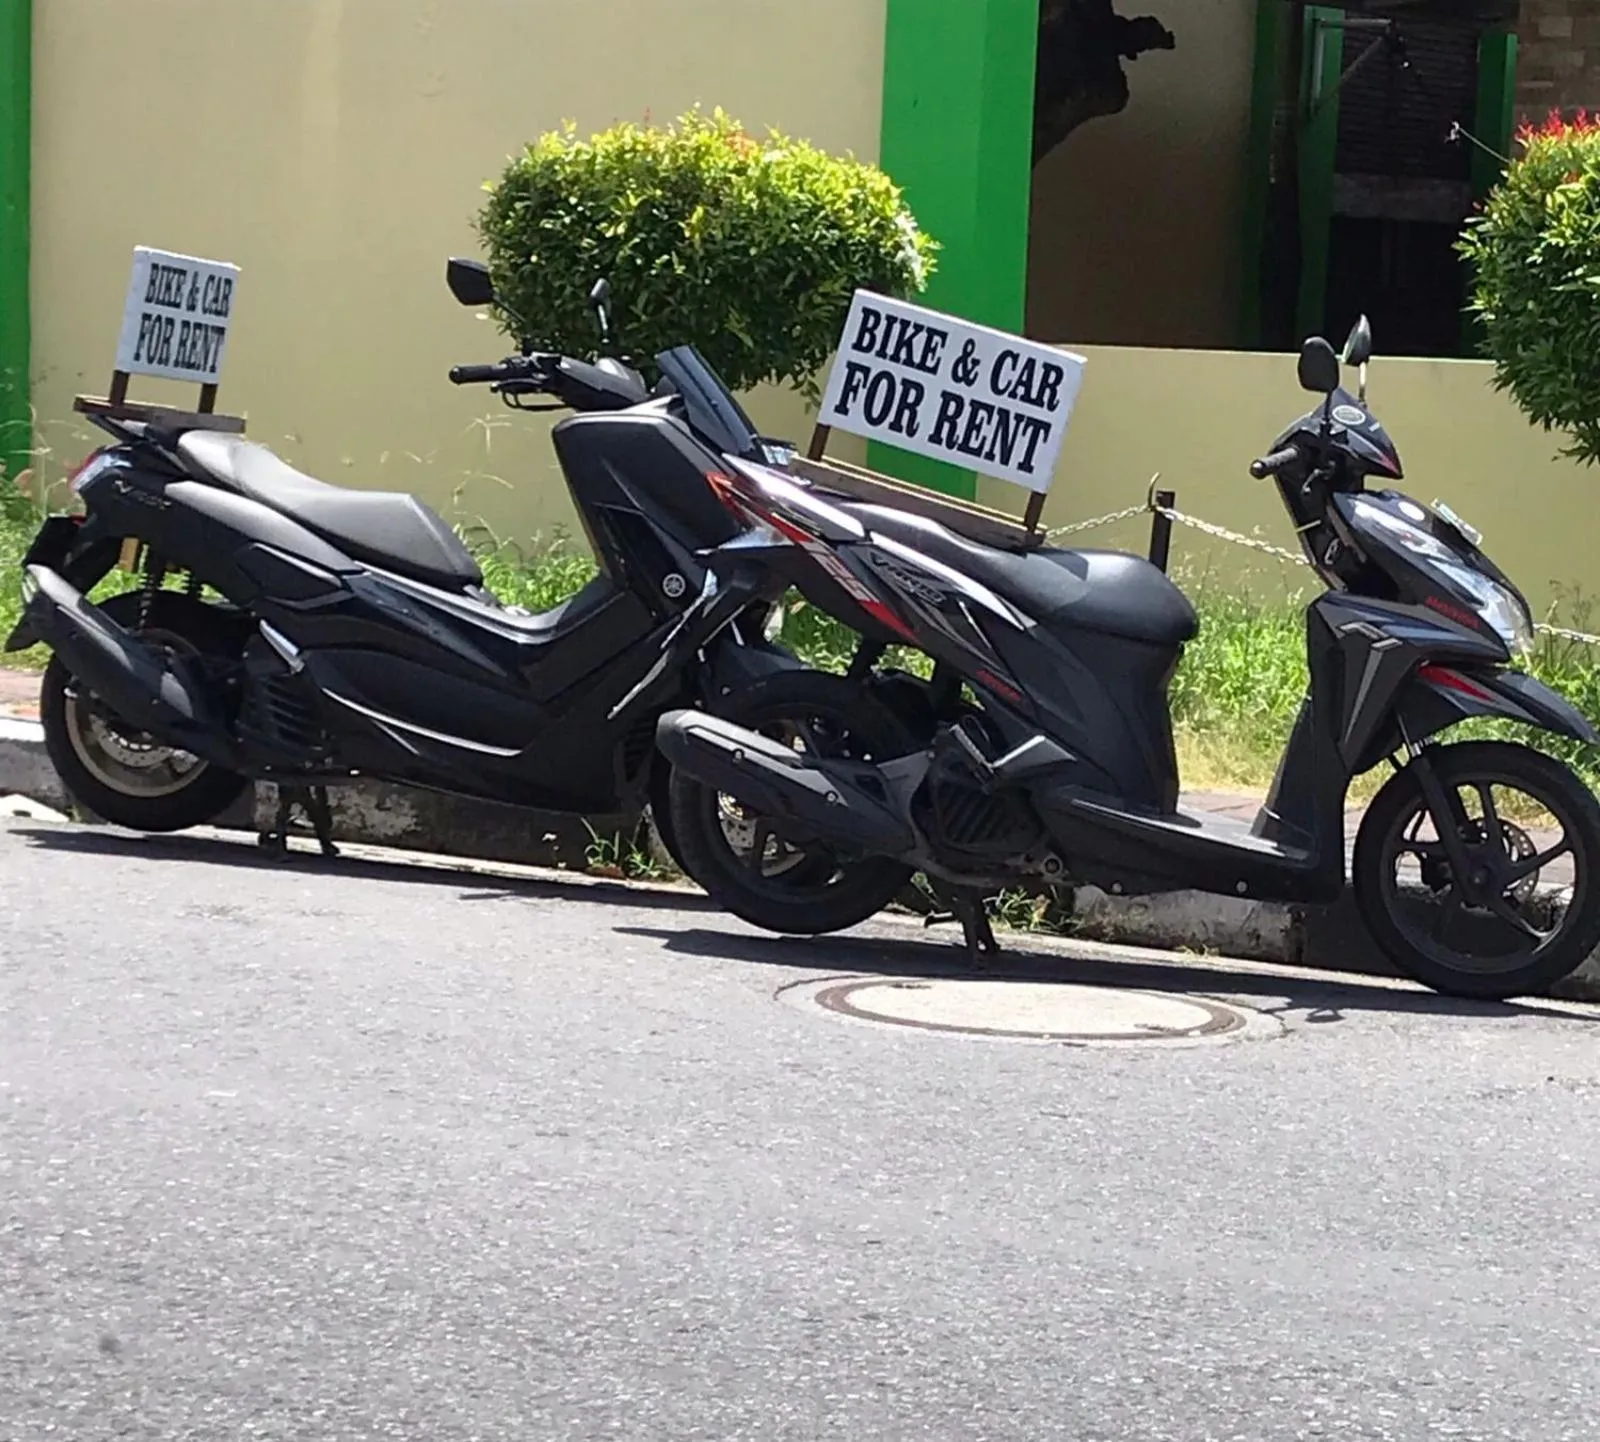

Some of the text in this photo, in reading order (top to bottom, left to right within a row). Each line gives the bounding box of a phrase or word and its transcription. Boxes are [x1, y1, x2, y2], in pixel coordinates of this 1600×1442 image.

[145, 263, 232, 318] BIKE & CAR
[133, 312, 226, 373] FOR RENT
[851, 306, 1064, 412] BIKE & CAR
[833, 360, 1052, 474] FOR RENT
